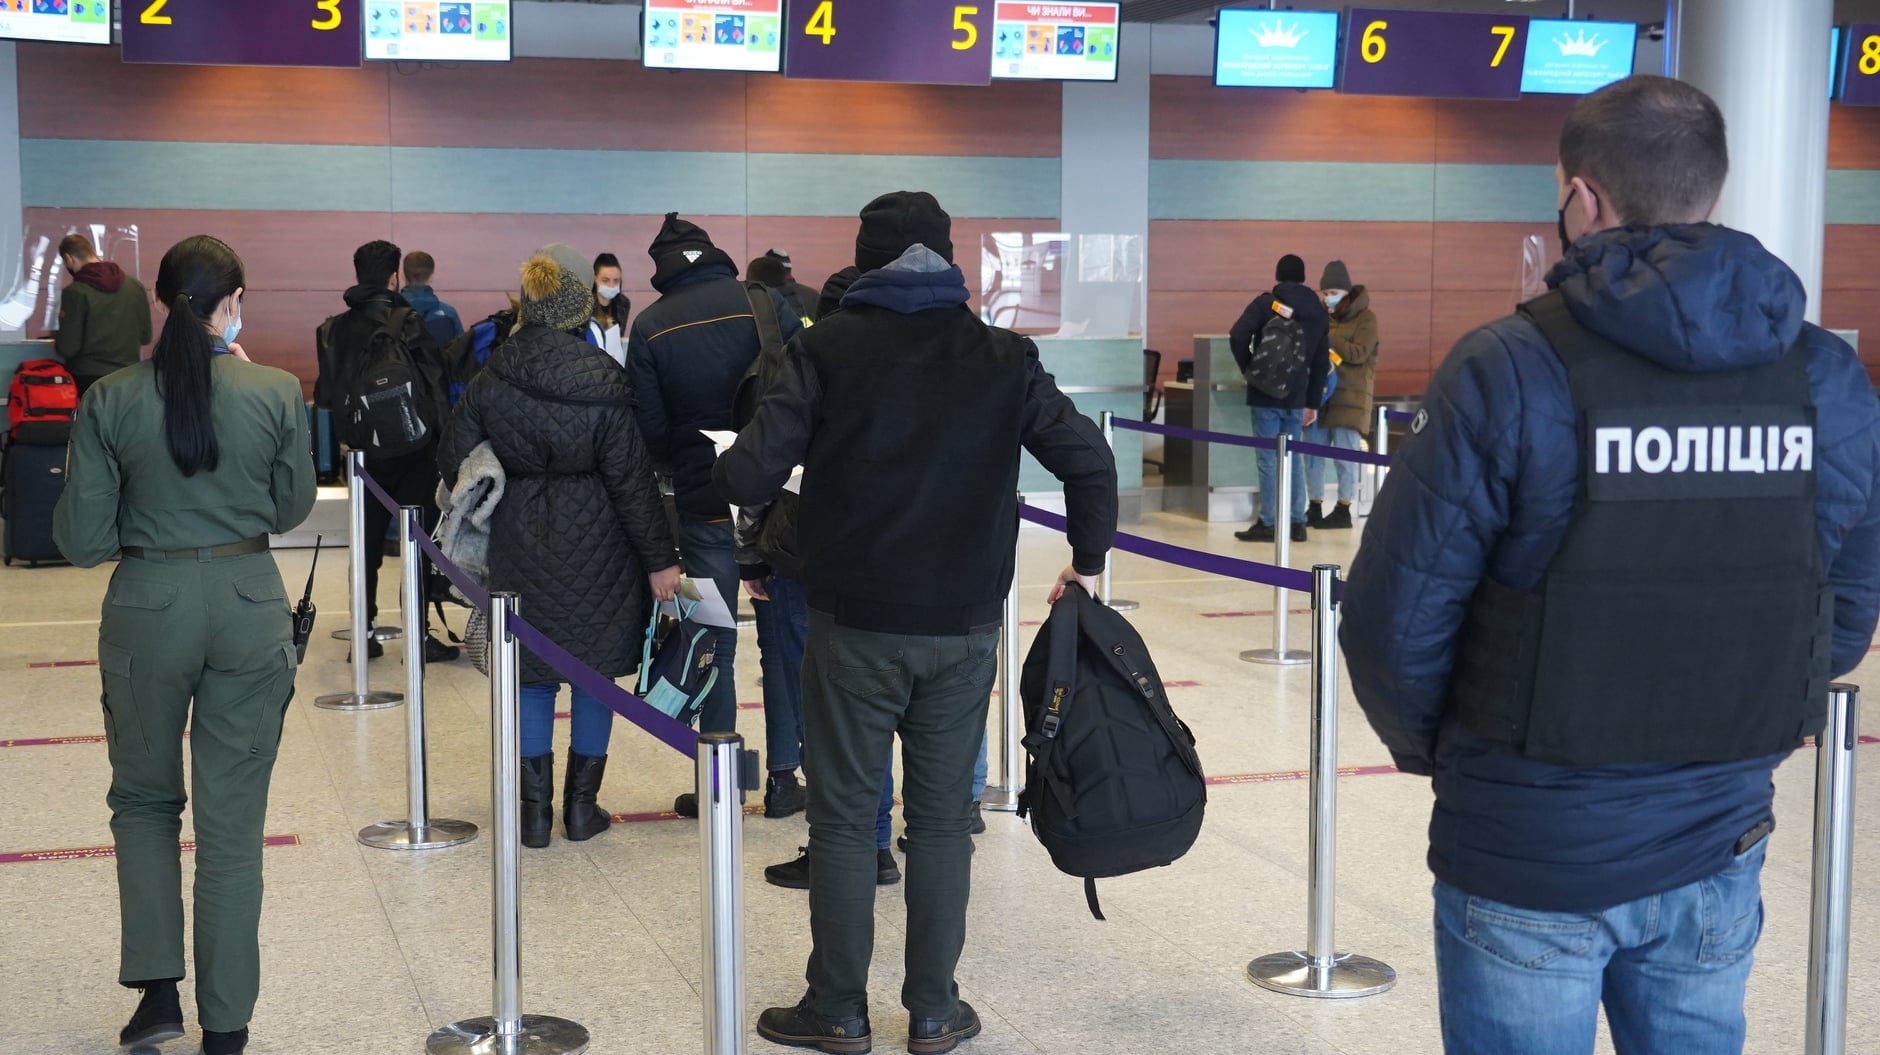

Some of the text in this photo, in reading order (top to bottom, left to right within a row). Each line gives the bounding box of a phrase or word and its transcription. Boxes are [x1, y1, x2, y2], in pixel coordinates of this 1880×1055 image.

[140, 0, 172, 25] 2
[312, 0, 342, 30] 3
[805, 1, 836, 45] 4
[951, 6, 978, 50] 5
[1027, 5, 1040, 16] ЧИ
[1041, 6, 1071, 17] ЗНАЛИ
[1361, 20, 1387, 63] 6
[1490, 26, 1515, 67] 7
[1858, 34, 1880, 75] 8
[1595, 425, 1813, 474] ПОЛІЦІЯ
